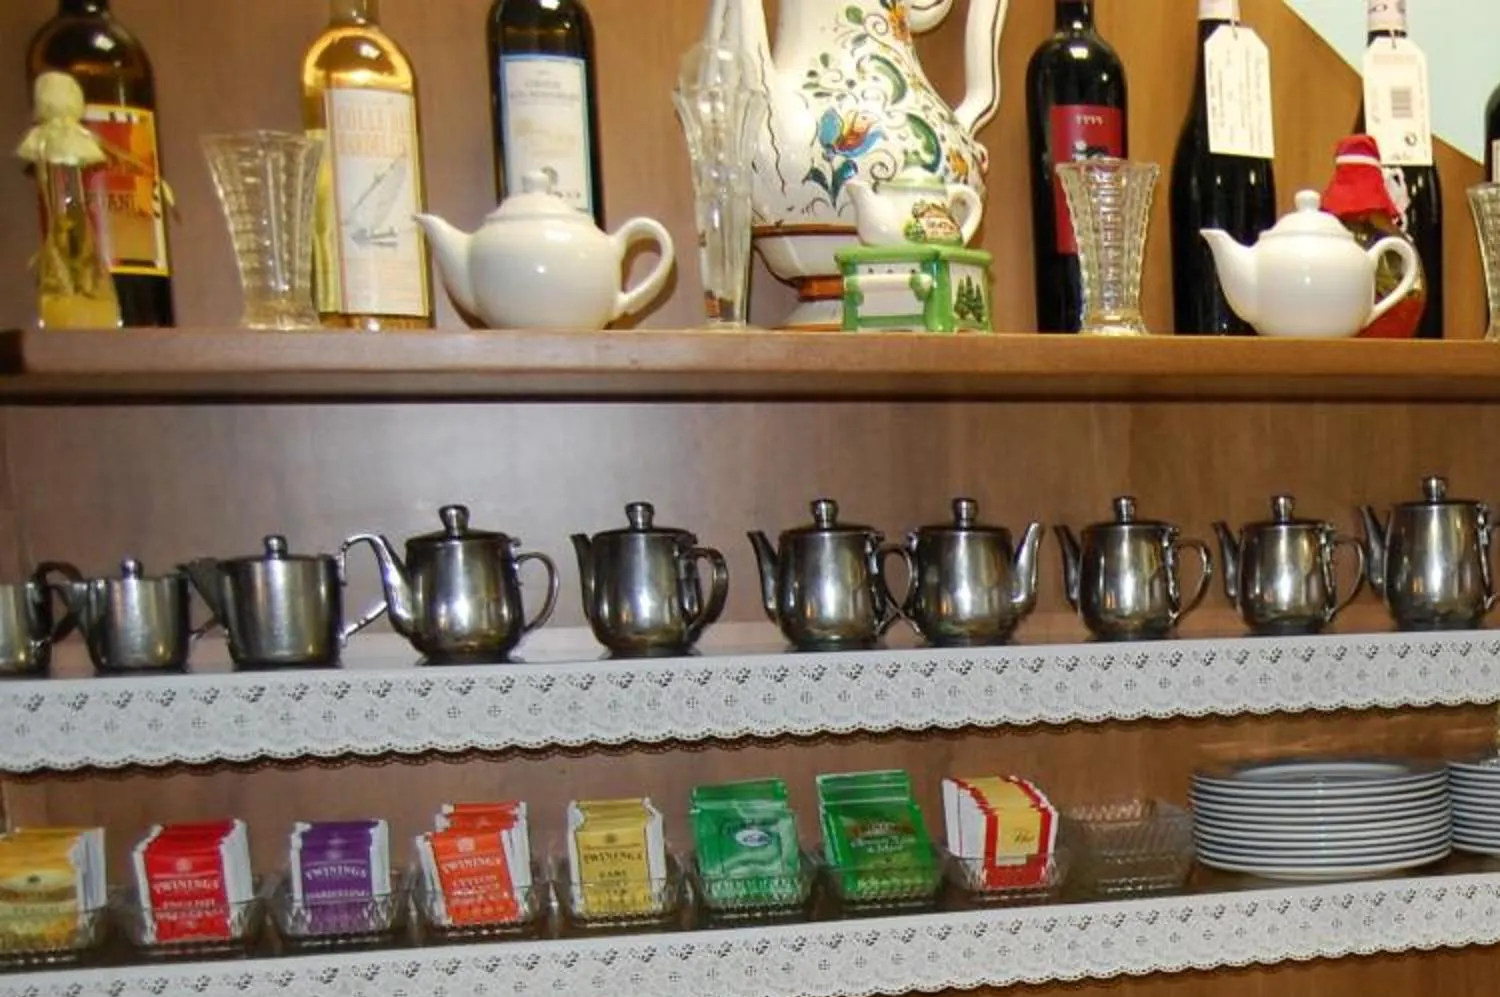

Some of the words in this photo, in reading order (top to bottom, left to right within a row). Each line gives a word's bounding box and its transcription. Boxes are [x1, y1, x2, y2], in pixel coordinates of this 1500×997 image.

[441, 855, 502, 873] TWININGS
[583, 850, 643, 865] TWININGS
[305, 865, 367, 880] TWININGS
[152, 879, 220, 894] TWININGS
